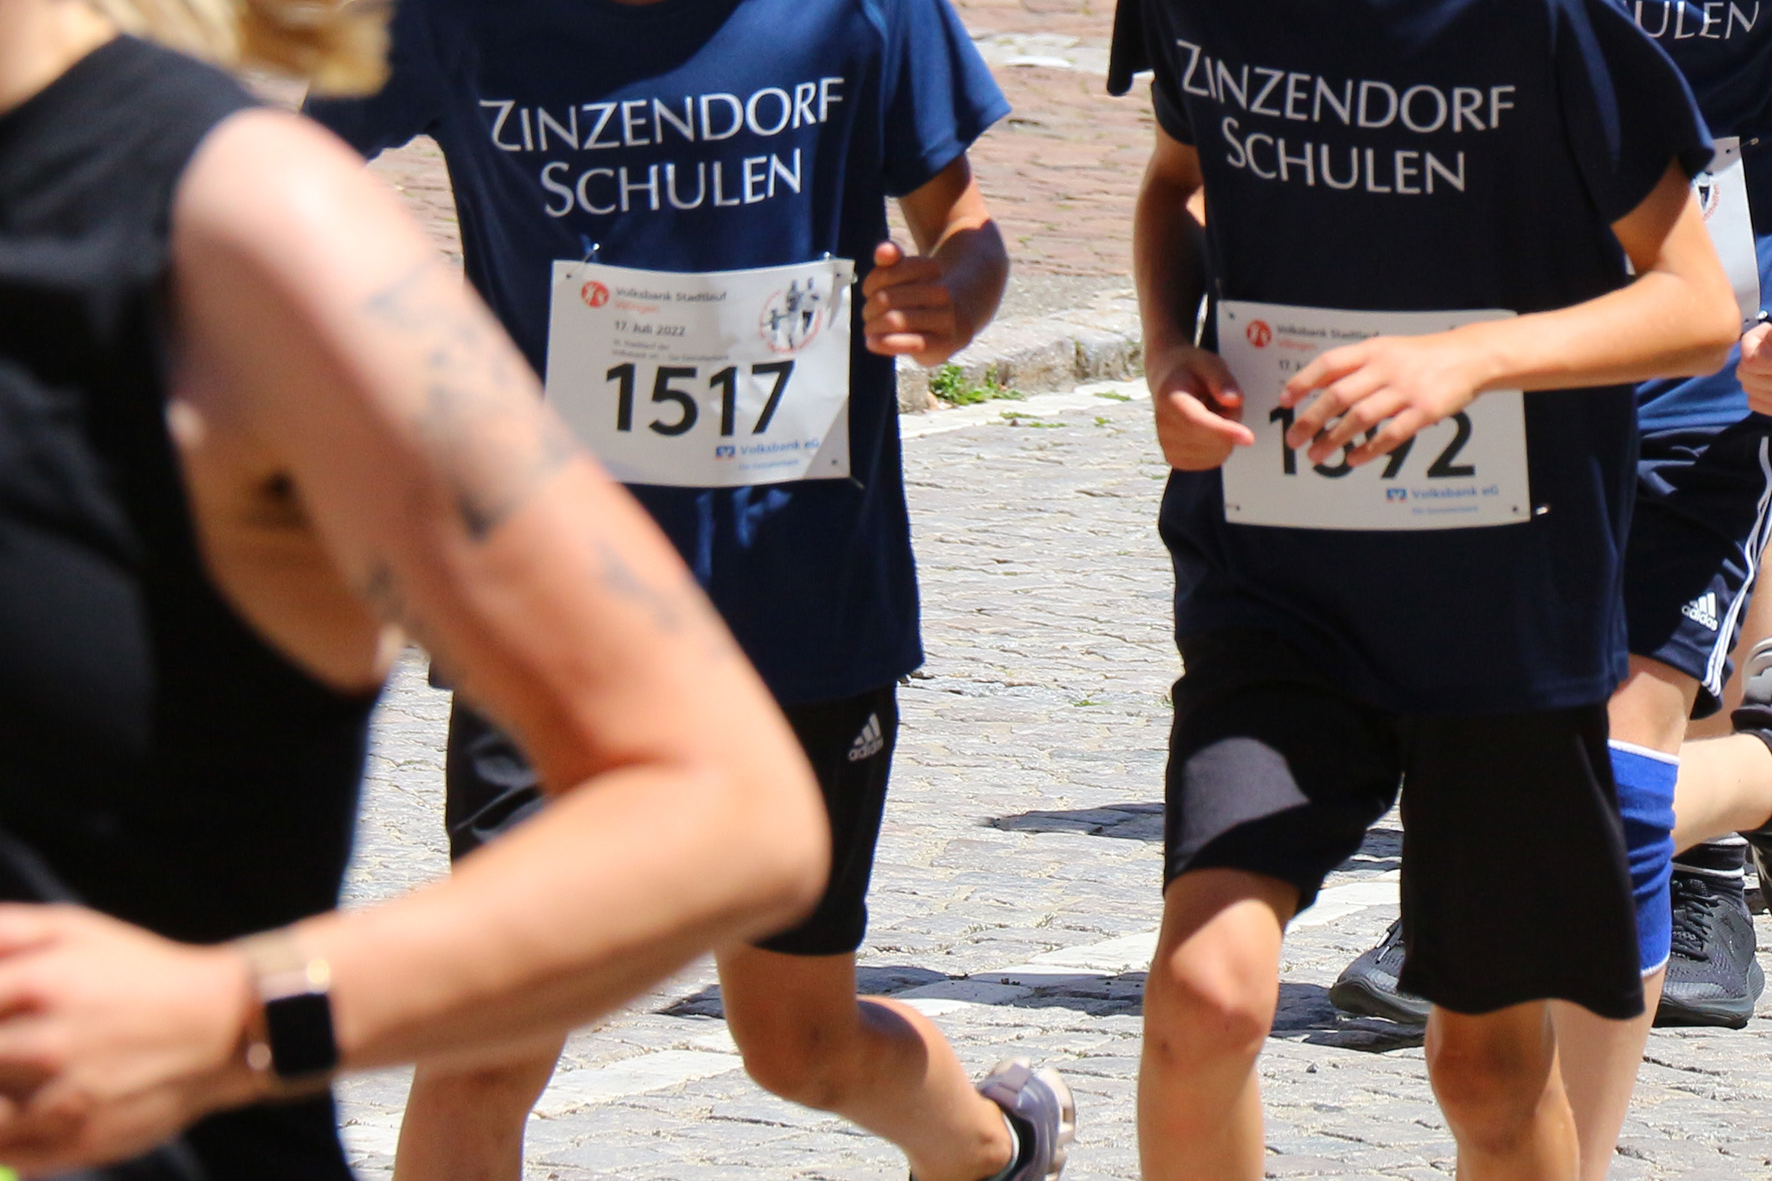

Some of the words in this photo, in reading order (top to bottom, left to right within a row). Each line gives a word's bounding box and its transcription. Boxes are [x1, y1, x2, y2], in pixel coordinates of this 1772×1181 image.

[479, 77, 845, 152] ZINZENDORF
[1175, 39, 1516, 134] ZINZENDORF
[540, 148, 802, 219] SCHULEN
[1221, 117, 1467, 195] SCHULEN
[606, 358, 796, 437] 1517
[1681, 604, 1719, 631] adidas
